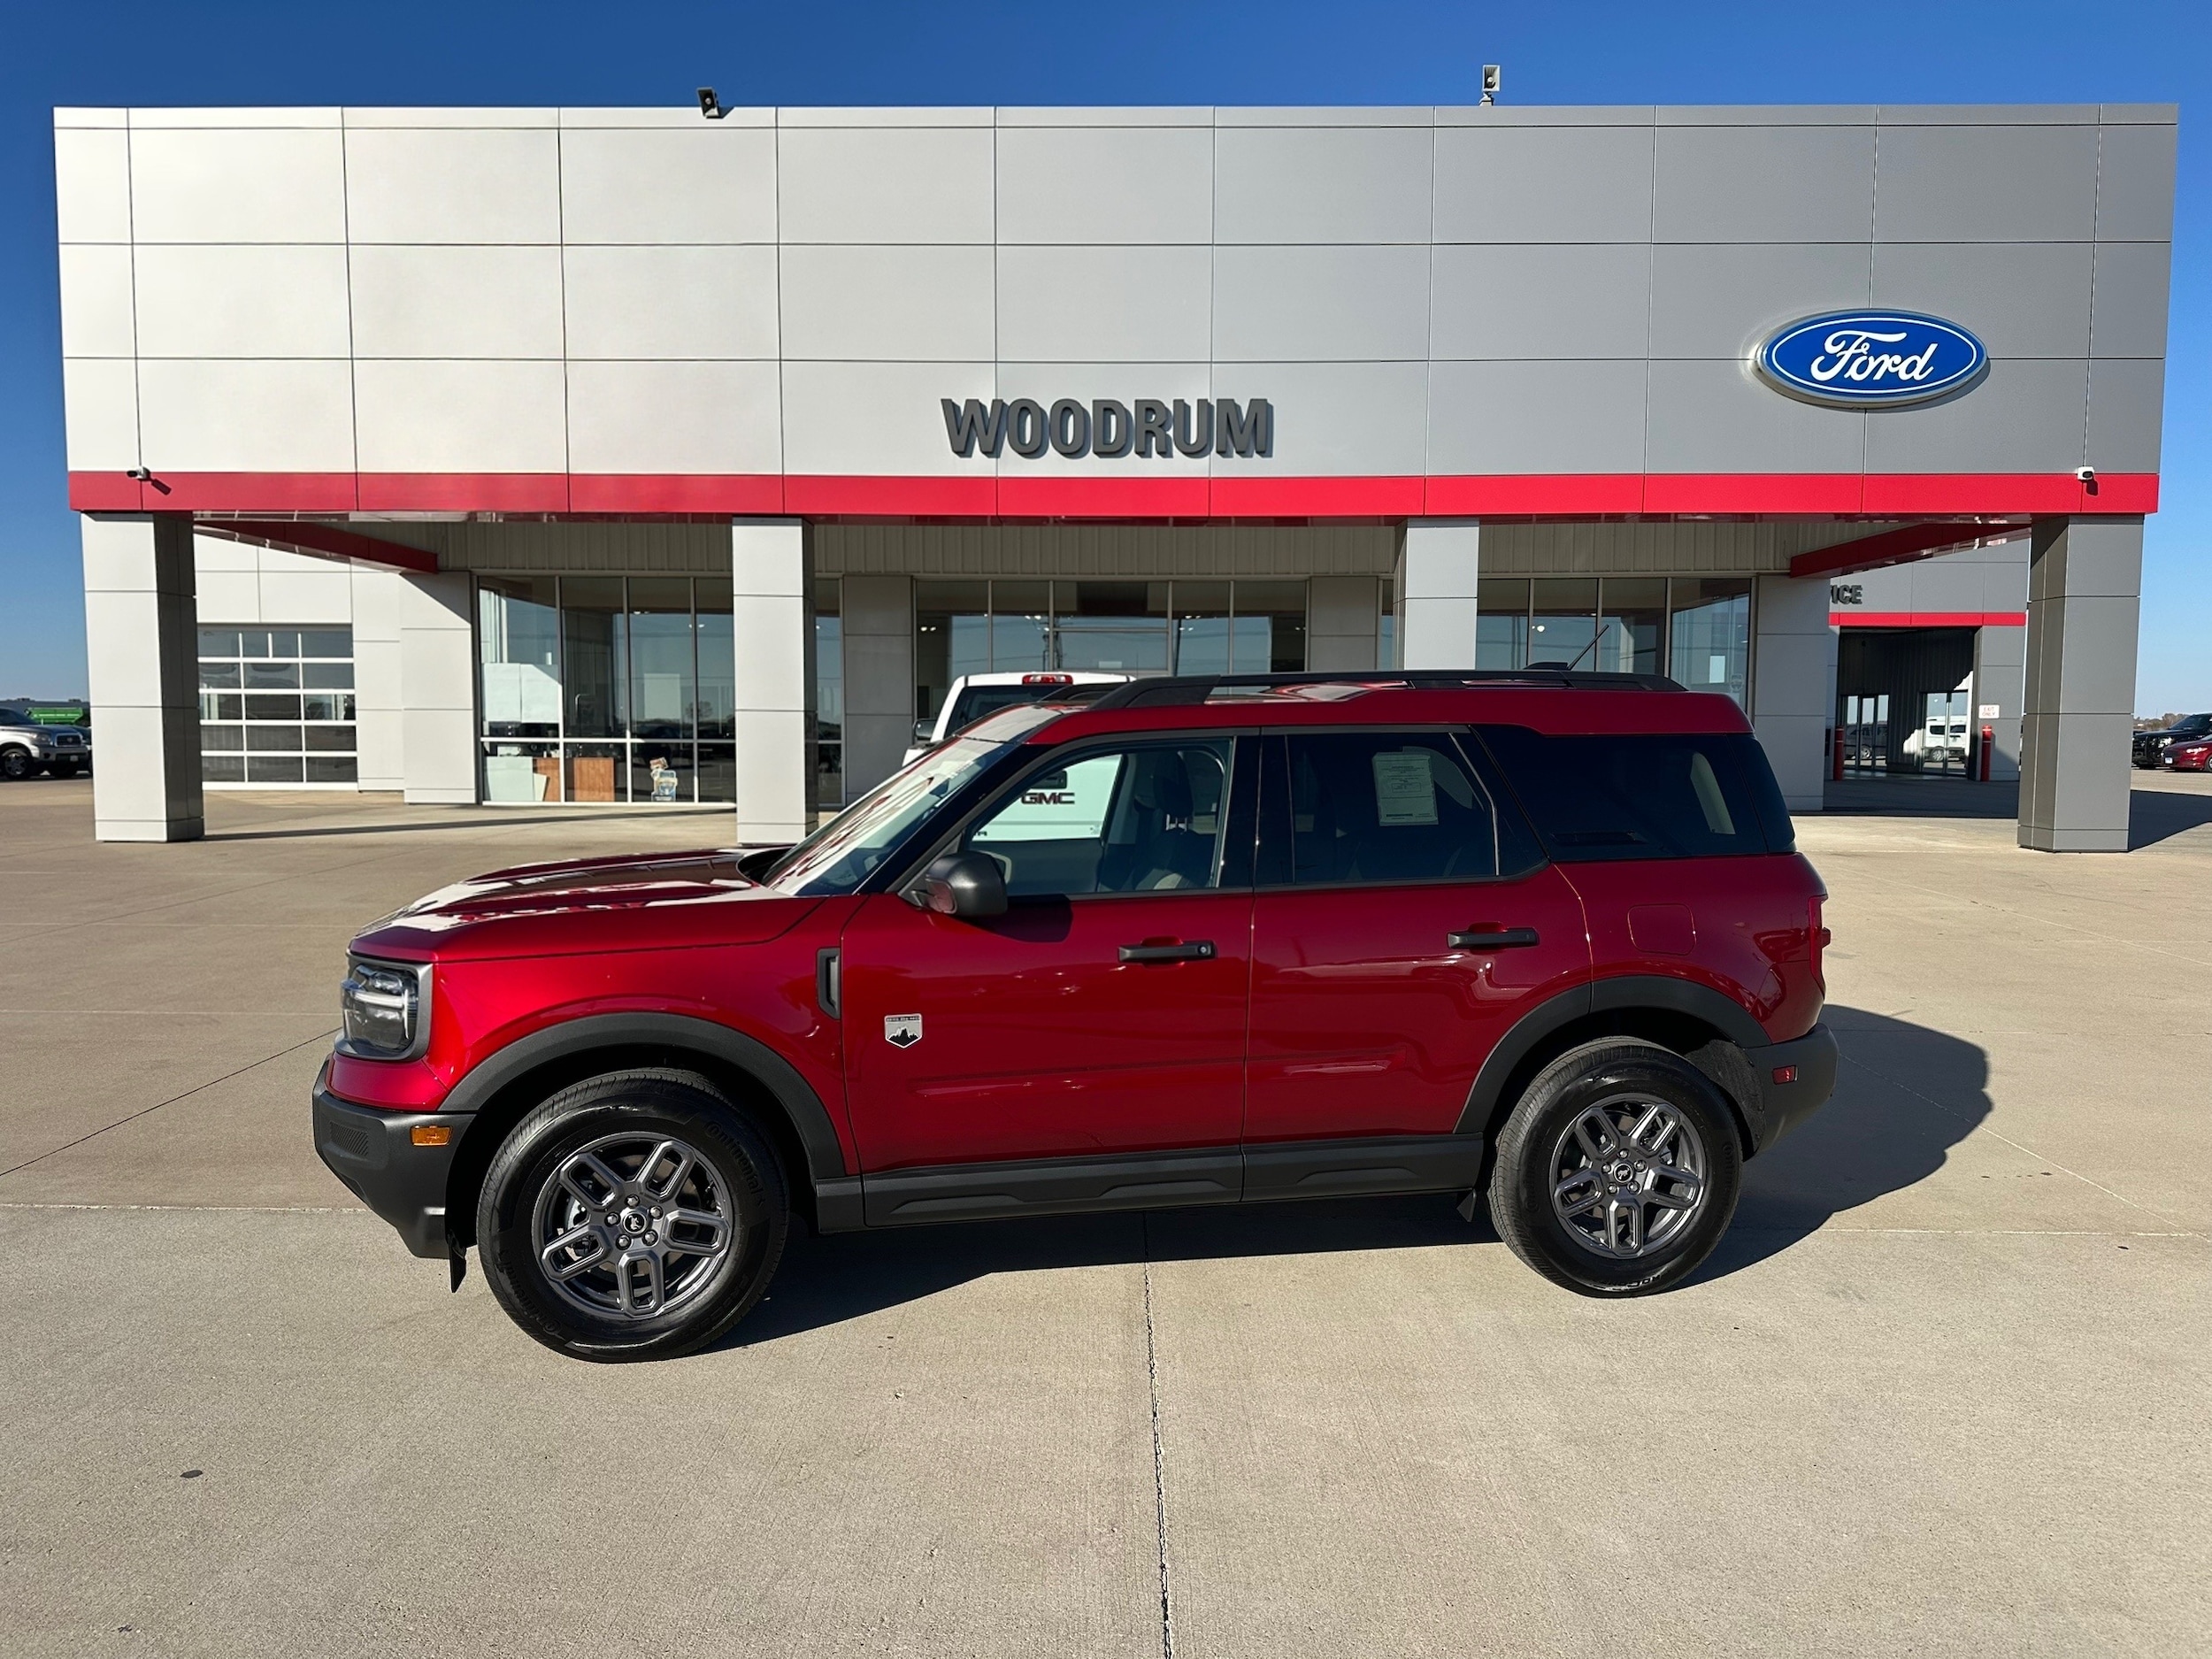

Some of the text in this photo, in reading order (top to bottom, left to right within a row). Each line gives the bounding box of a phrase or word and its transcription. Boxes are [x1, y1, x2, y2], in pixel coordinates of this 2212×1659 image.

[1810, 330, 1938, 380] Ford
[941, 398, 1272, 457] WOODRUM
[1831, 584, 1863, 604] ICE
[1021, 792, 1075, 804] GMC
